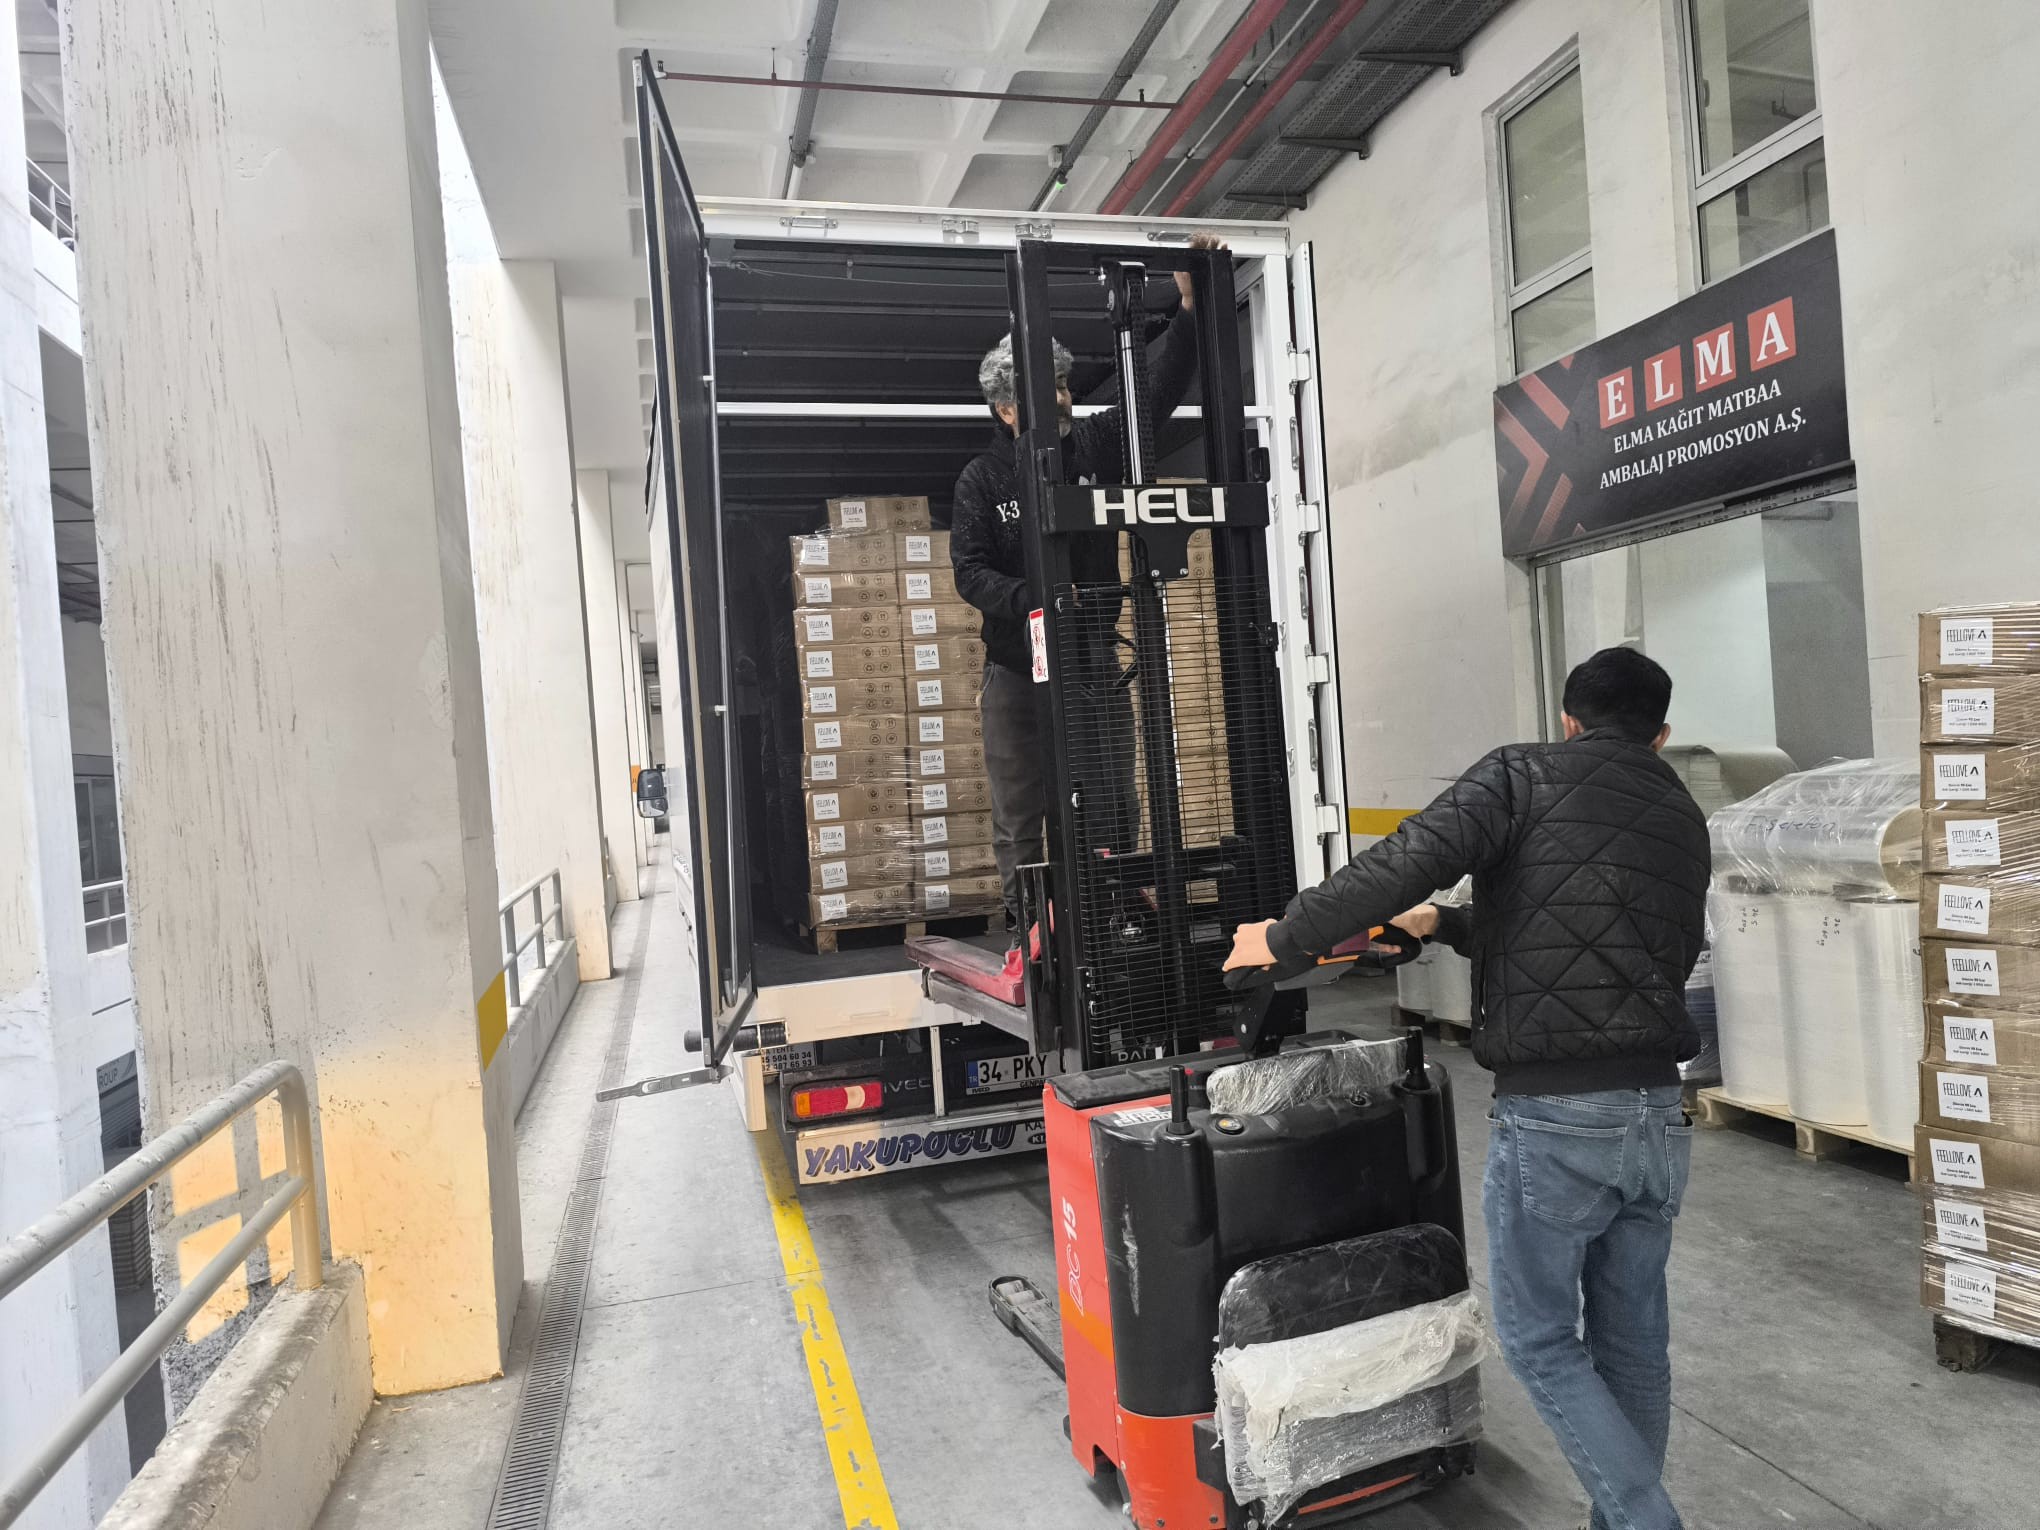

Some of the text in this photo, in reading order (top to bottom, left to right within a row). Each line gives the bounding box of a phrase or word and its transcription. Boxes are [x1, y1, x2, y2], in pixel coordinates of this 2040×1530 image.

[1605, 310, 1790, 421] ELMA
[1613, 379, 1782, 454] ELMA KAĞIT MATBAA
[1600, 408, 1807, 489] AMBALAJ PROMOSYON A.Ş.
[996, 500, 1020, 523] Y-3
[1092, 487, 1226, 526] HELI
[1939, 764, 1968, 778] FEELLOVE
[1944, 894, 1973, 910] FEELLOVE
[1952, 958, 1981, 972] FEELLOVE
[1949, 1026, 1977, 1041] FEELLOVE
[979, 1061, 1002, 1084] 34
[1013, 1055, 1047, 1080] PKY
[883, 1079, 931, 1094] IVEC
[1943, 1082, 1972, 1098] FEELLOVE
[1936, 1149, 1965, 1165] FEELLOVE
[1062, 1196, 1078, 1241] 15
[1940, 1210, 1969, 1227] FEELLOVE
